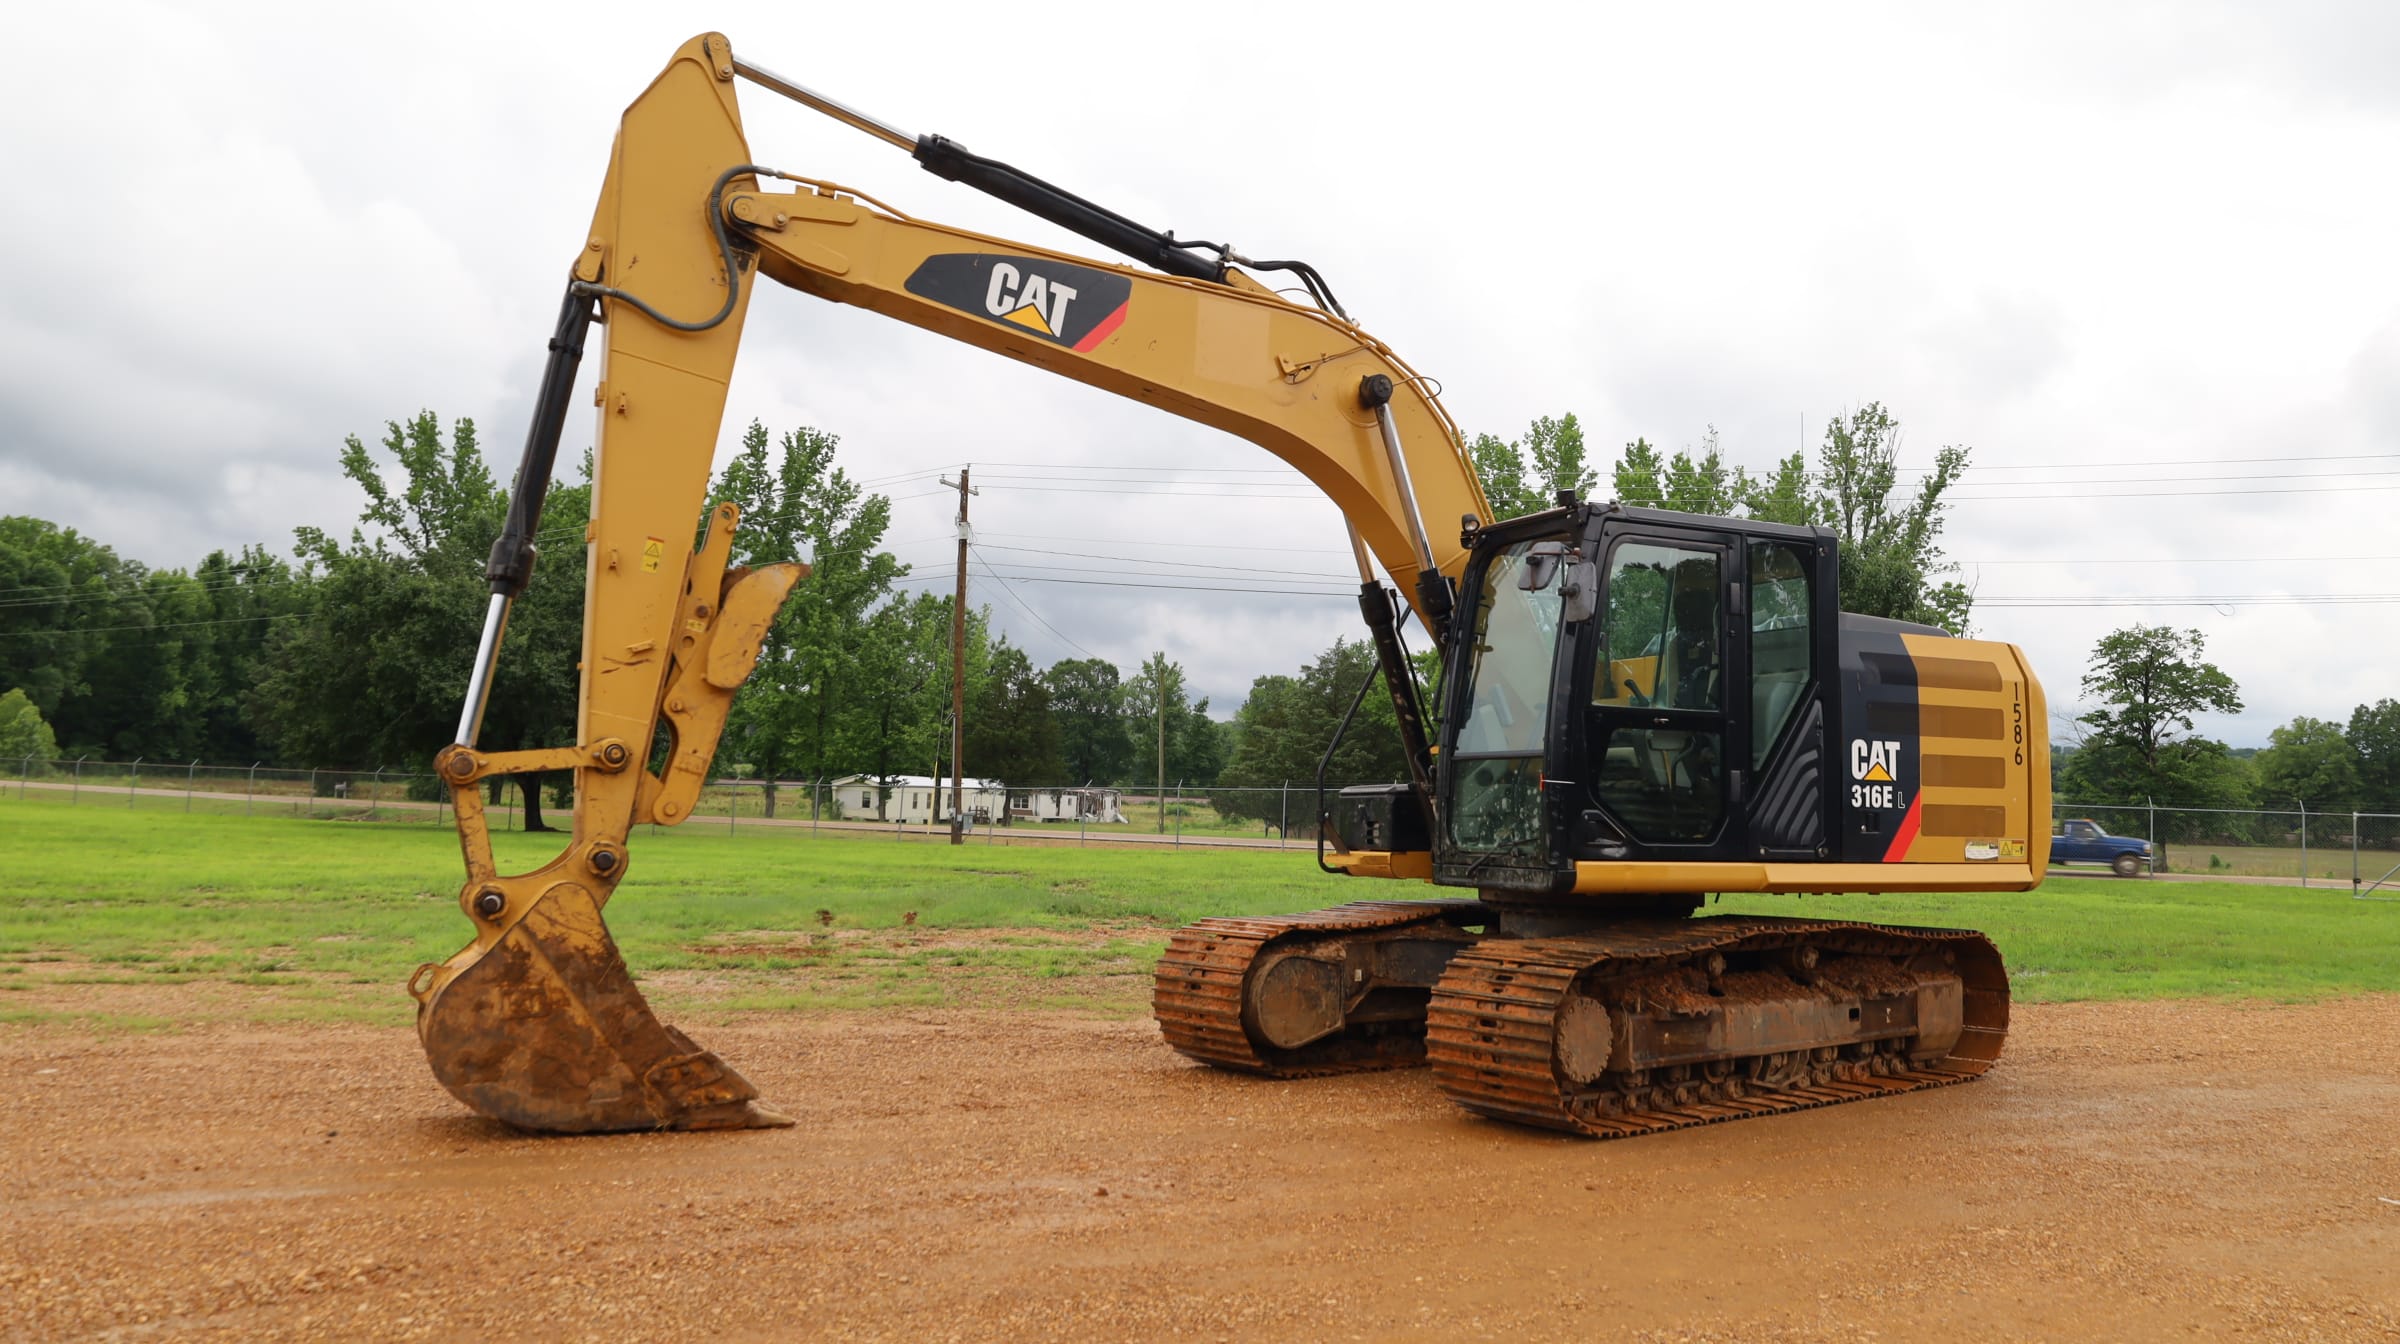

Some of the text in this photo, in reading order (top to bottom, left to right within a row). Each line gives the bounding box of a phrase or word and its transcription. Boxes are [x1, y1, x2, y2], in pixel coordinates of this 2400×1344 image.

[985, 262, 1078, 338] CAT
[2013, 681, 2023, 766] 1586
[1851, 738, 1900, 782] CAT
[1851, 784, 1906, 809] 316E L
